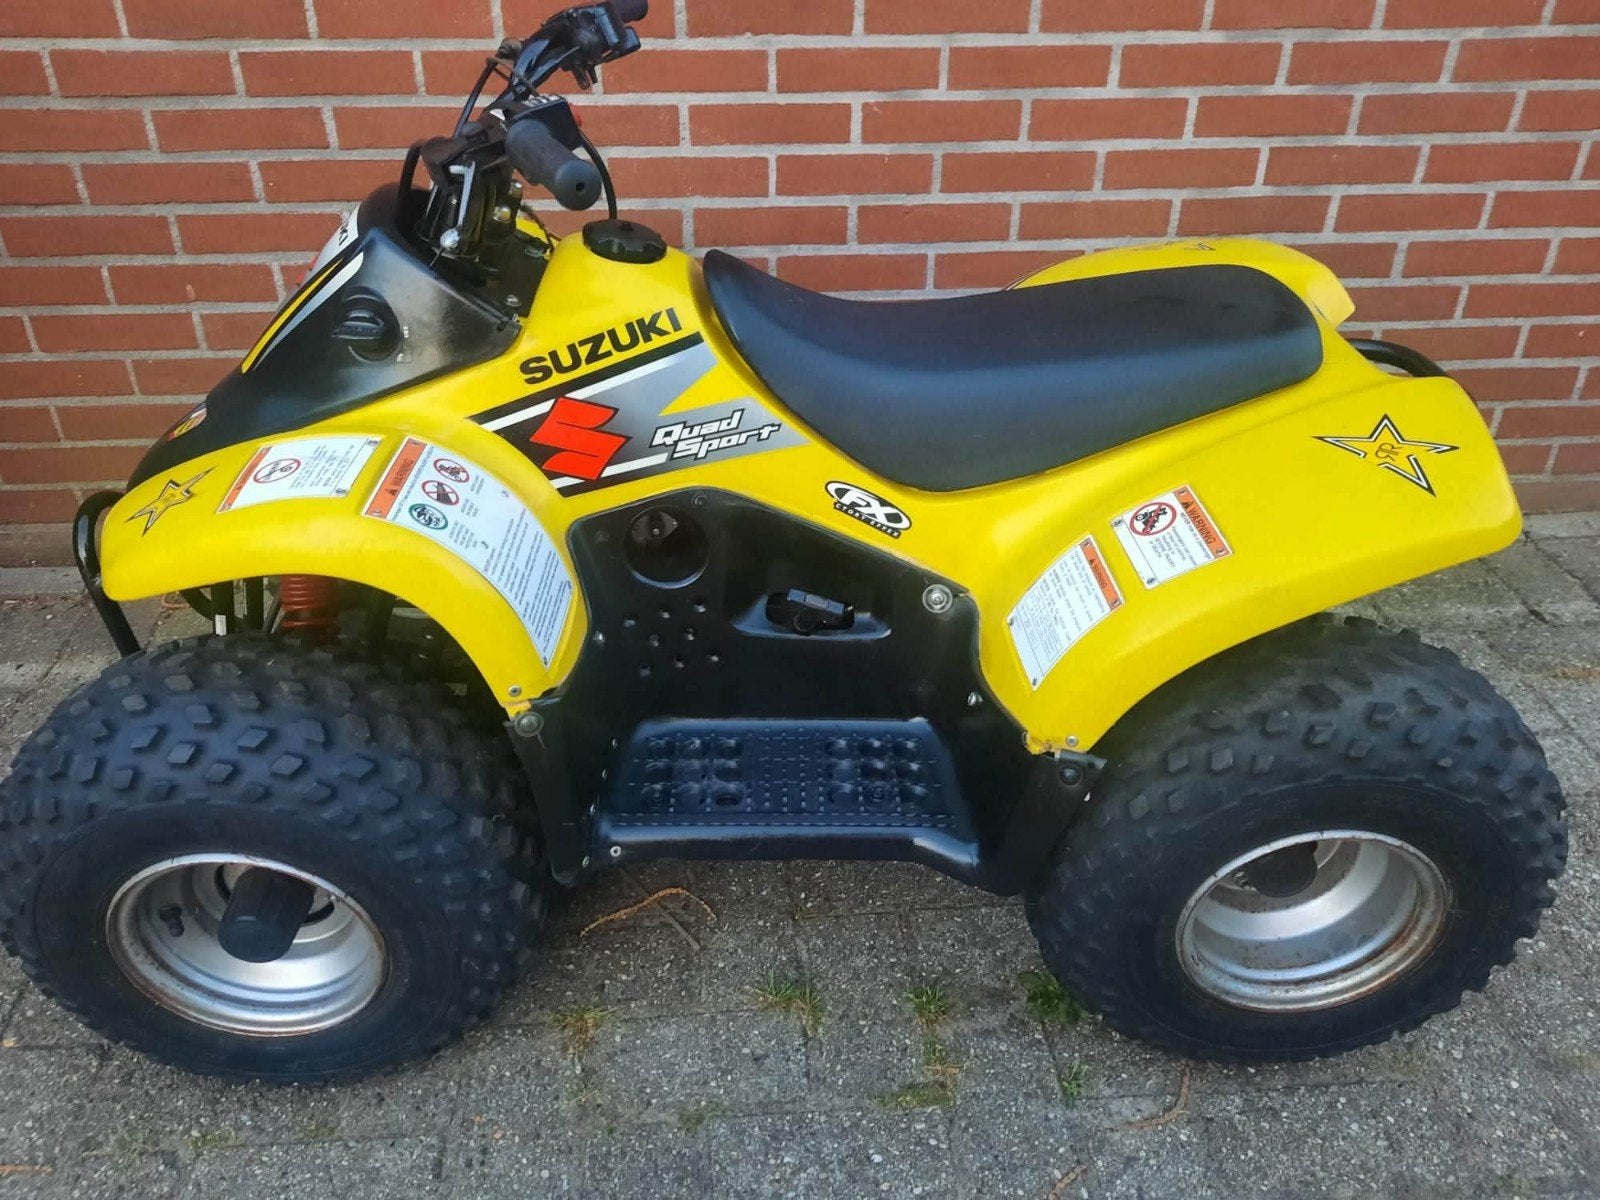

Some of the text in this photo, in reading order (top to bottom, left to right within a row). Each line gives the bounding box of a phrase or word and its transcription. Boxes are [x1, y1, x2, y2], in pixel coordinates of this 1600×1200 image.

[519, 307, 683, 385] SUZUKI
[650, 409, 745, 448] Quad
[669, 423, 782, 461] Sport
[1187, 507, 1214, 545] WARNING
